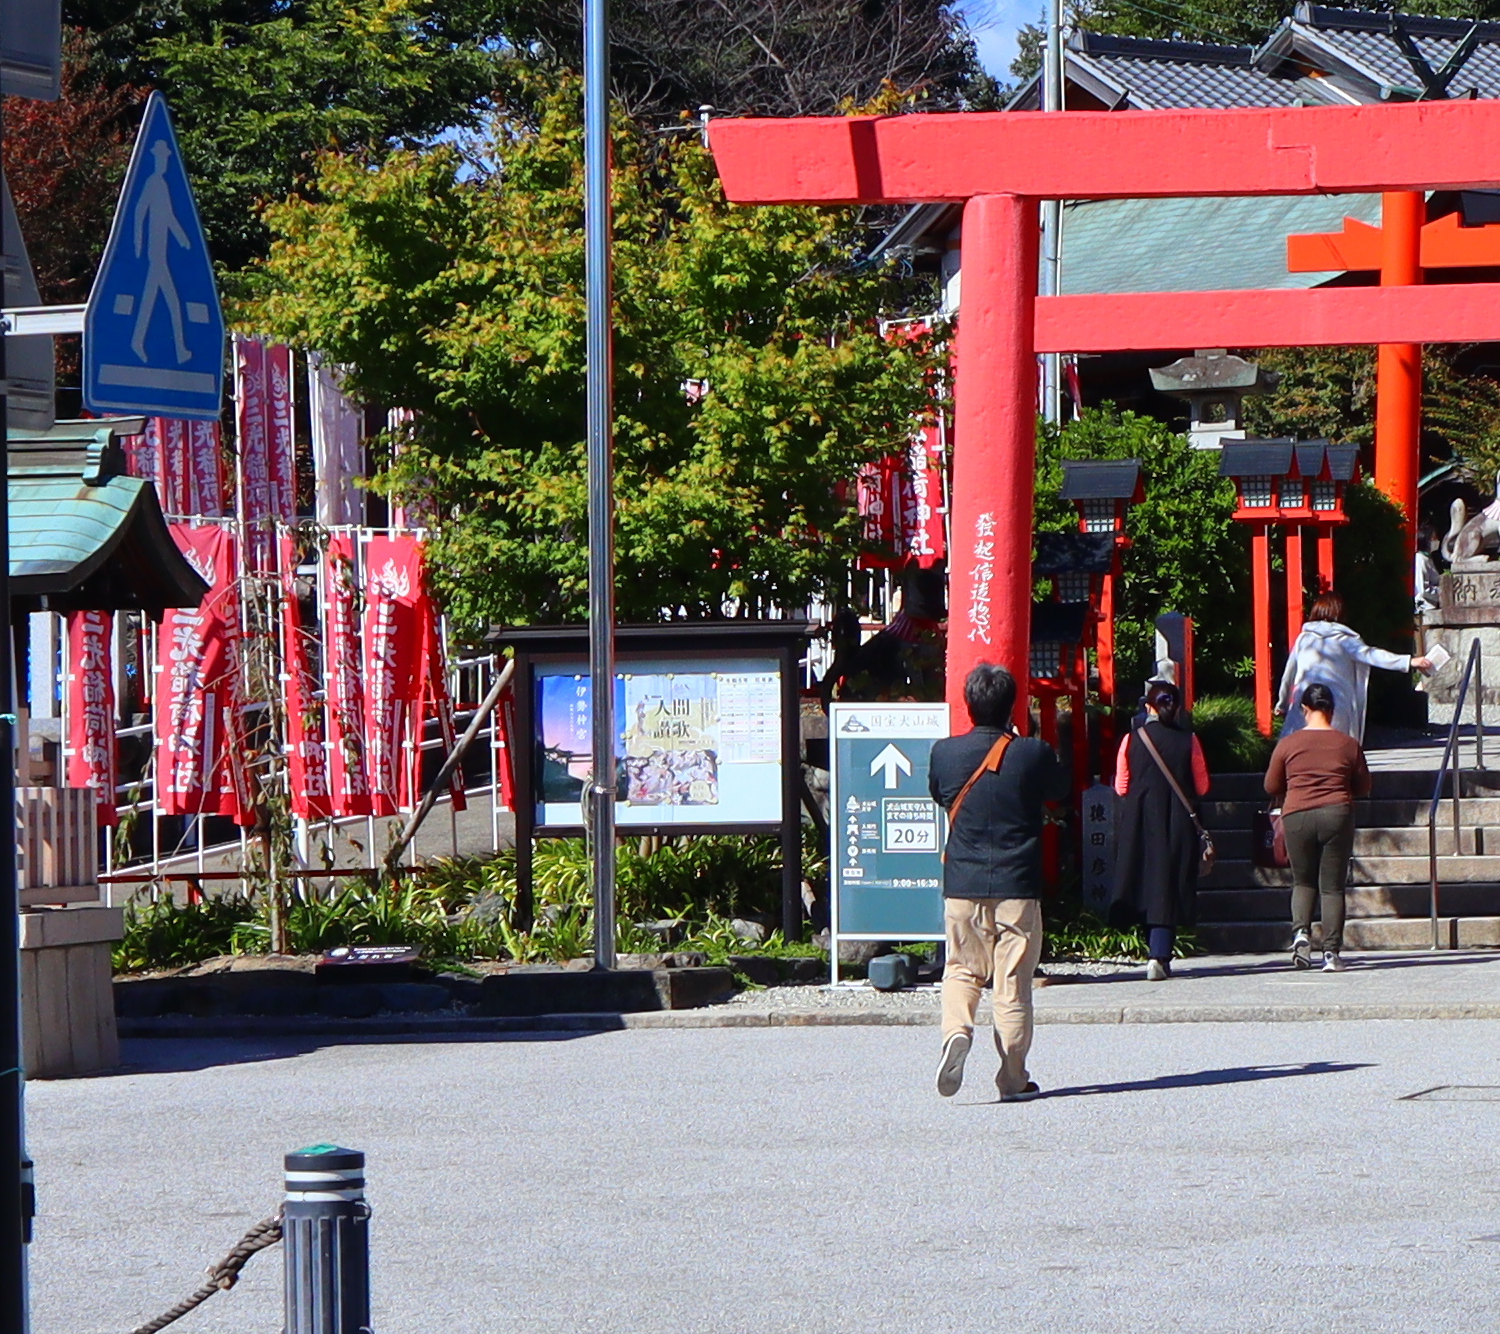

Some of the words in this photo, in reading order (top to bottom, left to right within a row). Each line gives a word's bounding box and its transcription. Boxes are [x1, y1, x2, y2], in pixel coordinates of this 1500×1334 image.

[903, 430, 936, 556] 稲荷神社
[894, 828, 929, 843] 20分
